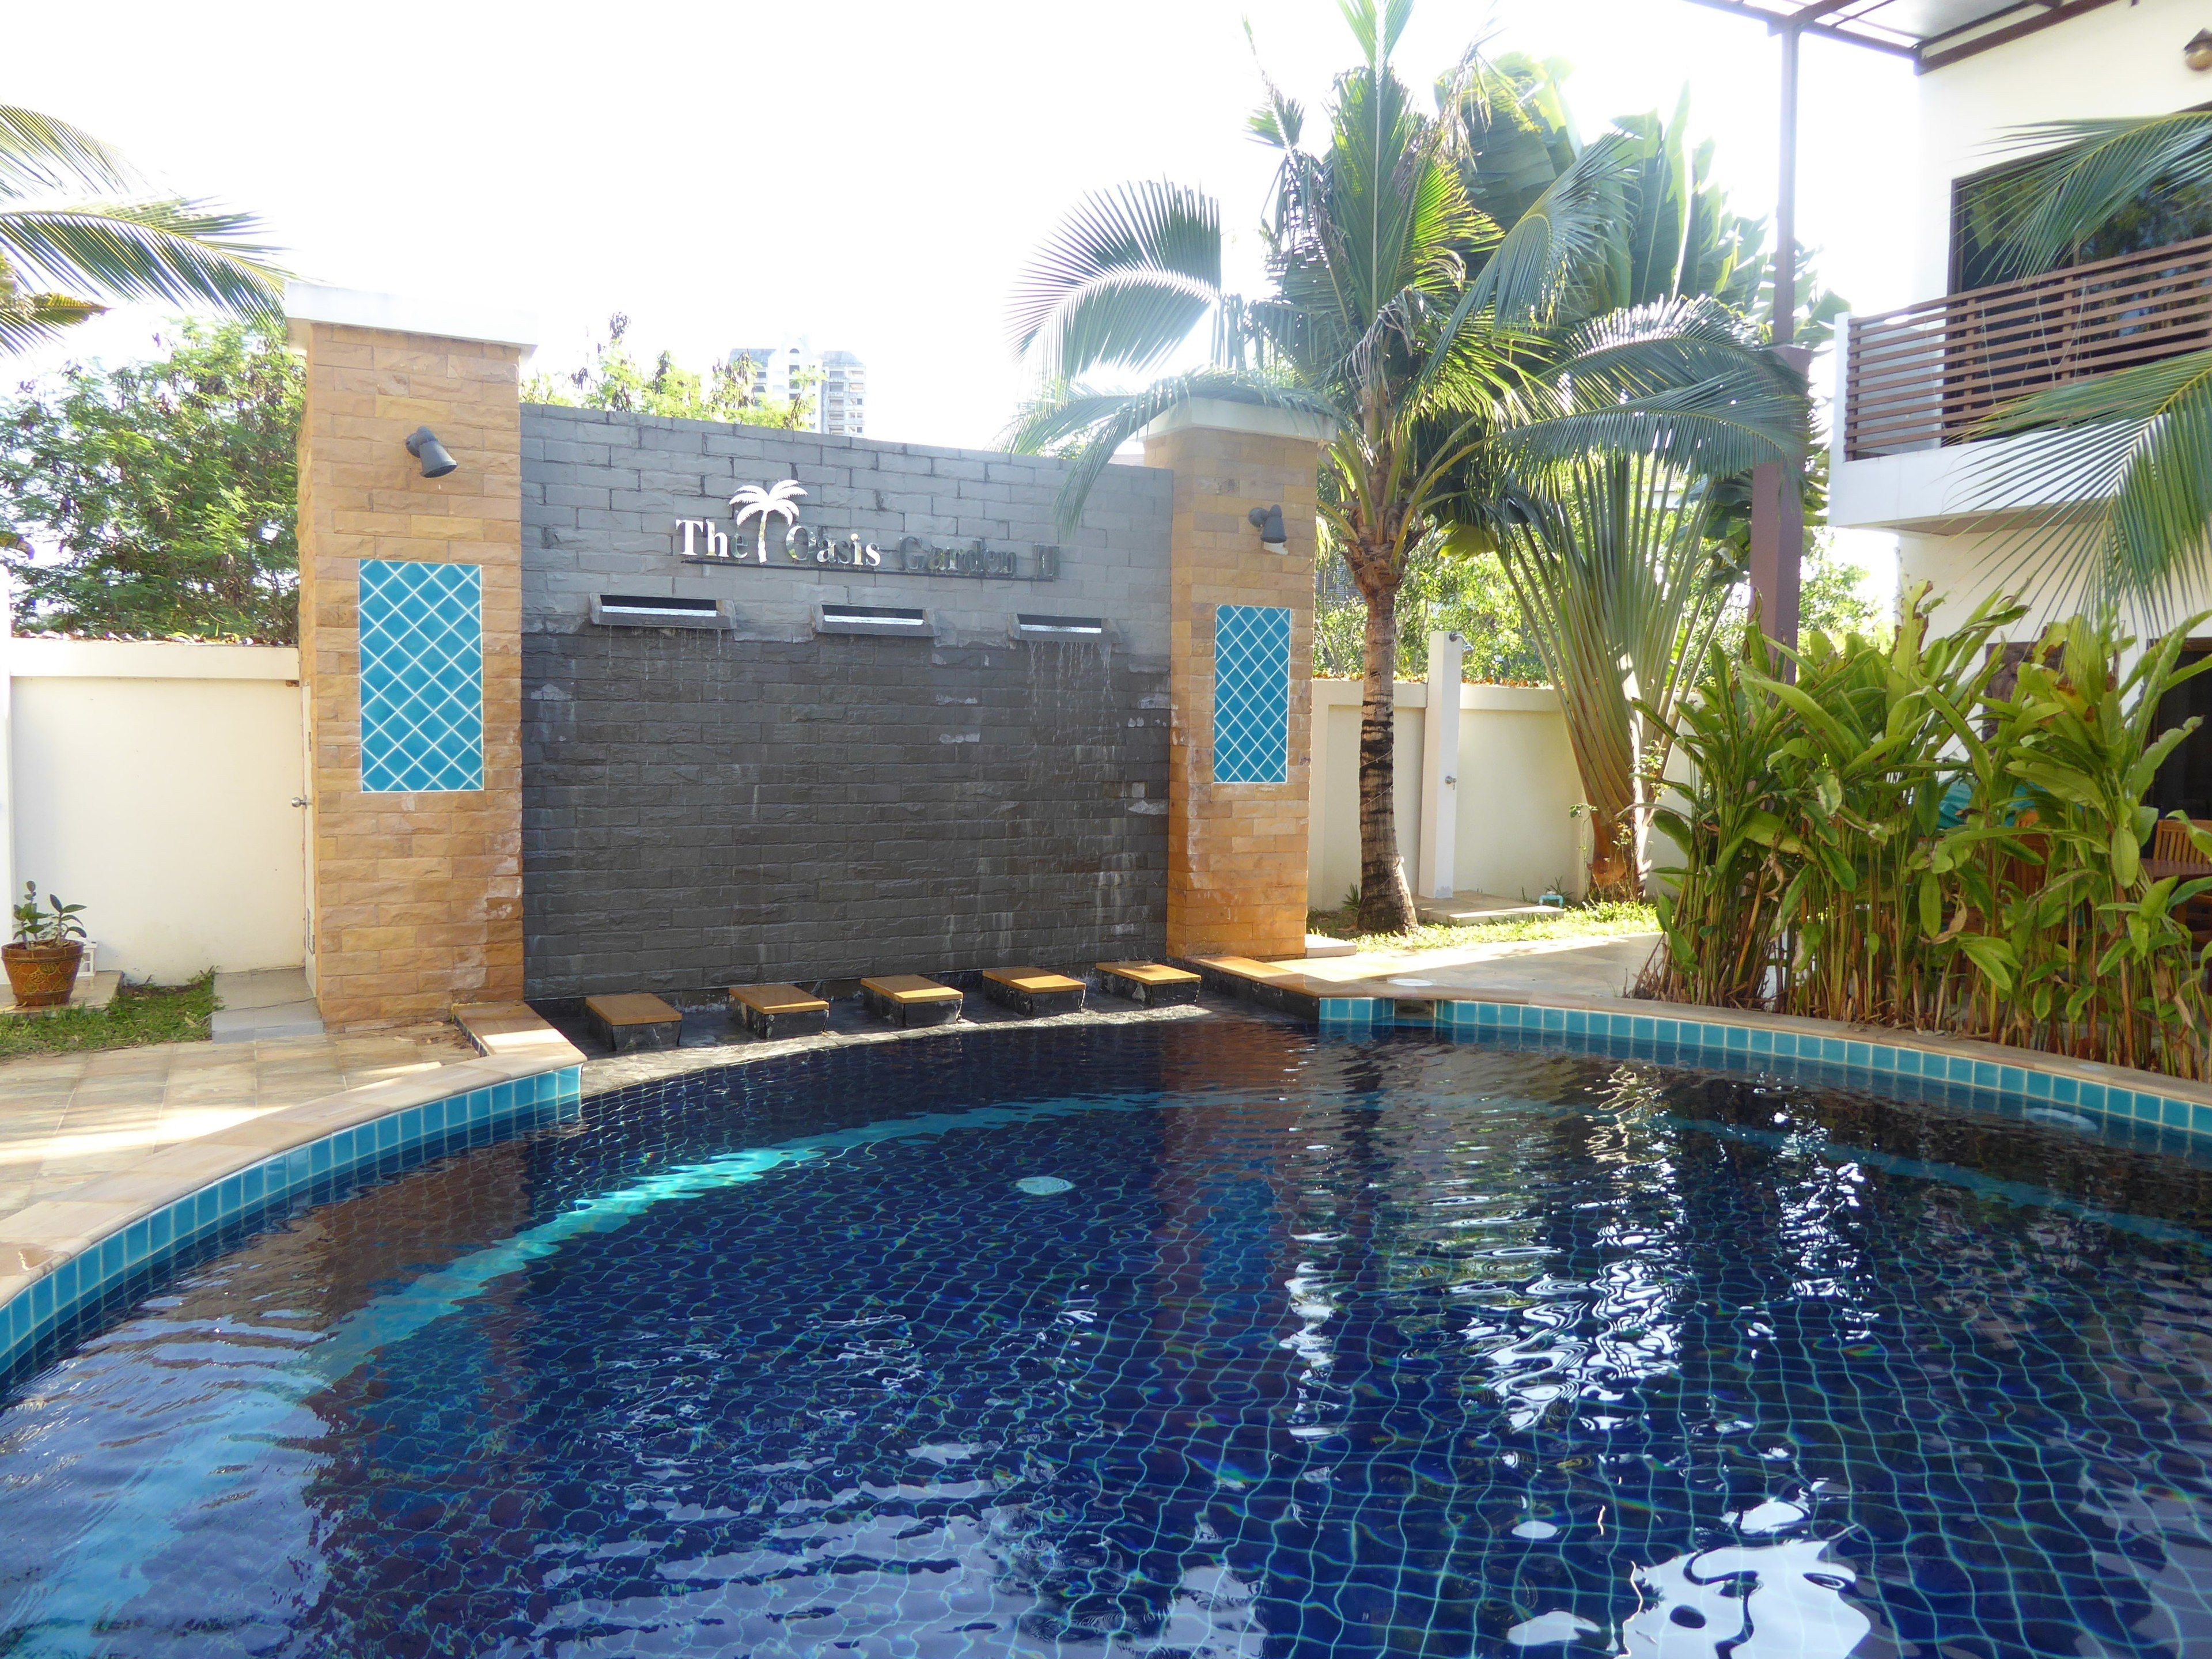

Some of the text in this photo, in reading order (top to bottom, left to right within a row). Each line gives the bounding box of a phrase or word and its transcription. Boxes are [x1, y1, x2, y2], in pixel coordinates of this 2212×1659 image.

[676, 520, 748, 559] The
[786, 525, 882, 566] Oasis
[899, 536, 1017, 576] Garden
